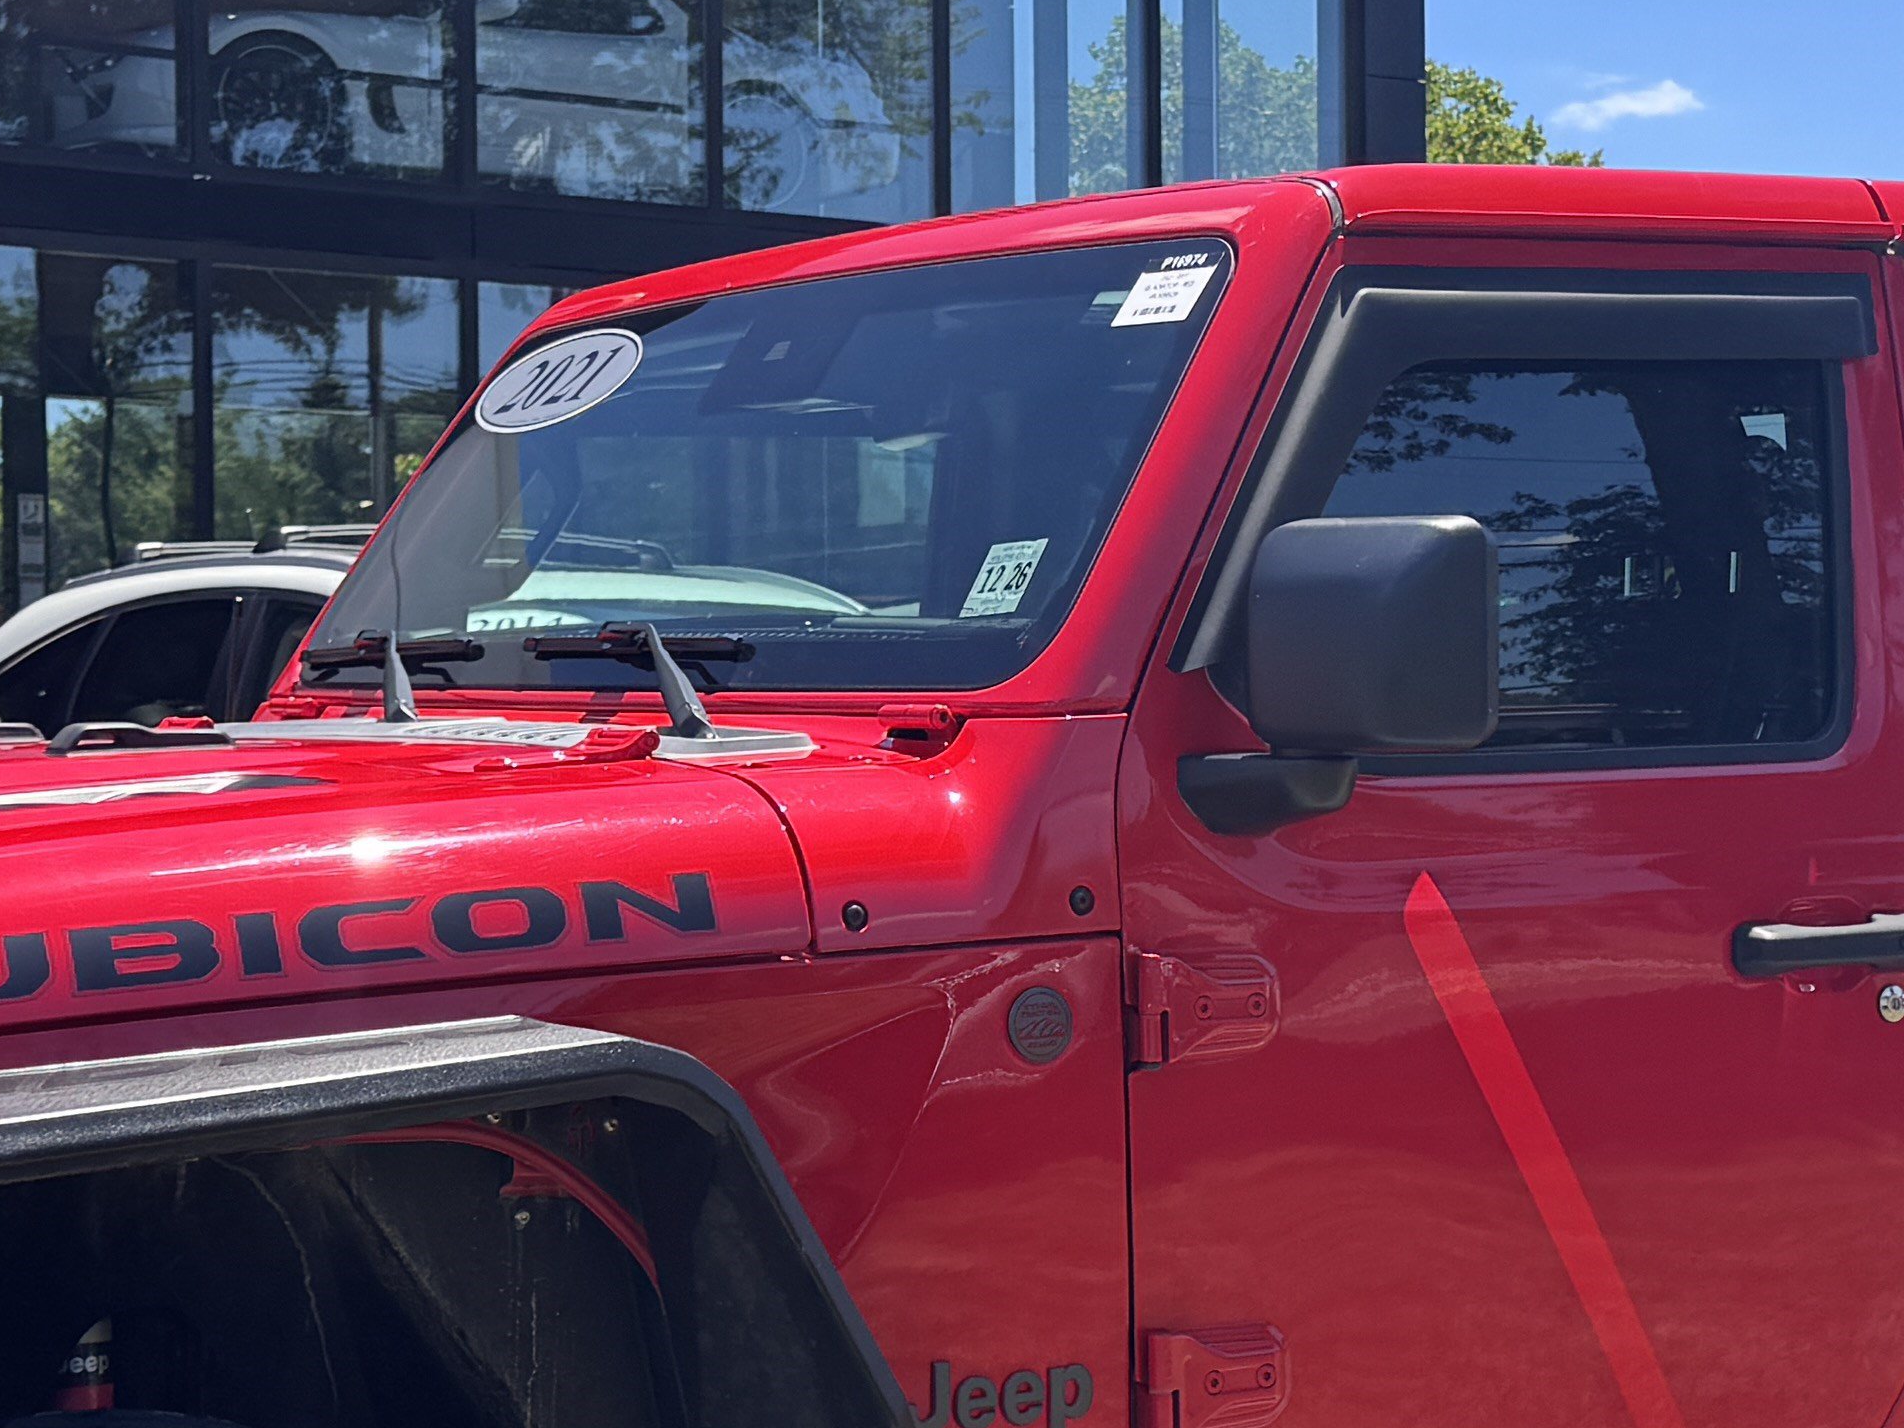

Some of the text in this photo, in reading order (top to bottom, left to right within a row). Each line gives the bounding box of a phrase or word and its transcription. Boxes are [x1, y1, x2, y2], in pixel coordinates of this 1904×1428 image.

[492, 343, 627, 415] 2021
[977, 561, 1034, 594] 12 26
[58, 1355, 110, 1376] Jeep
